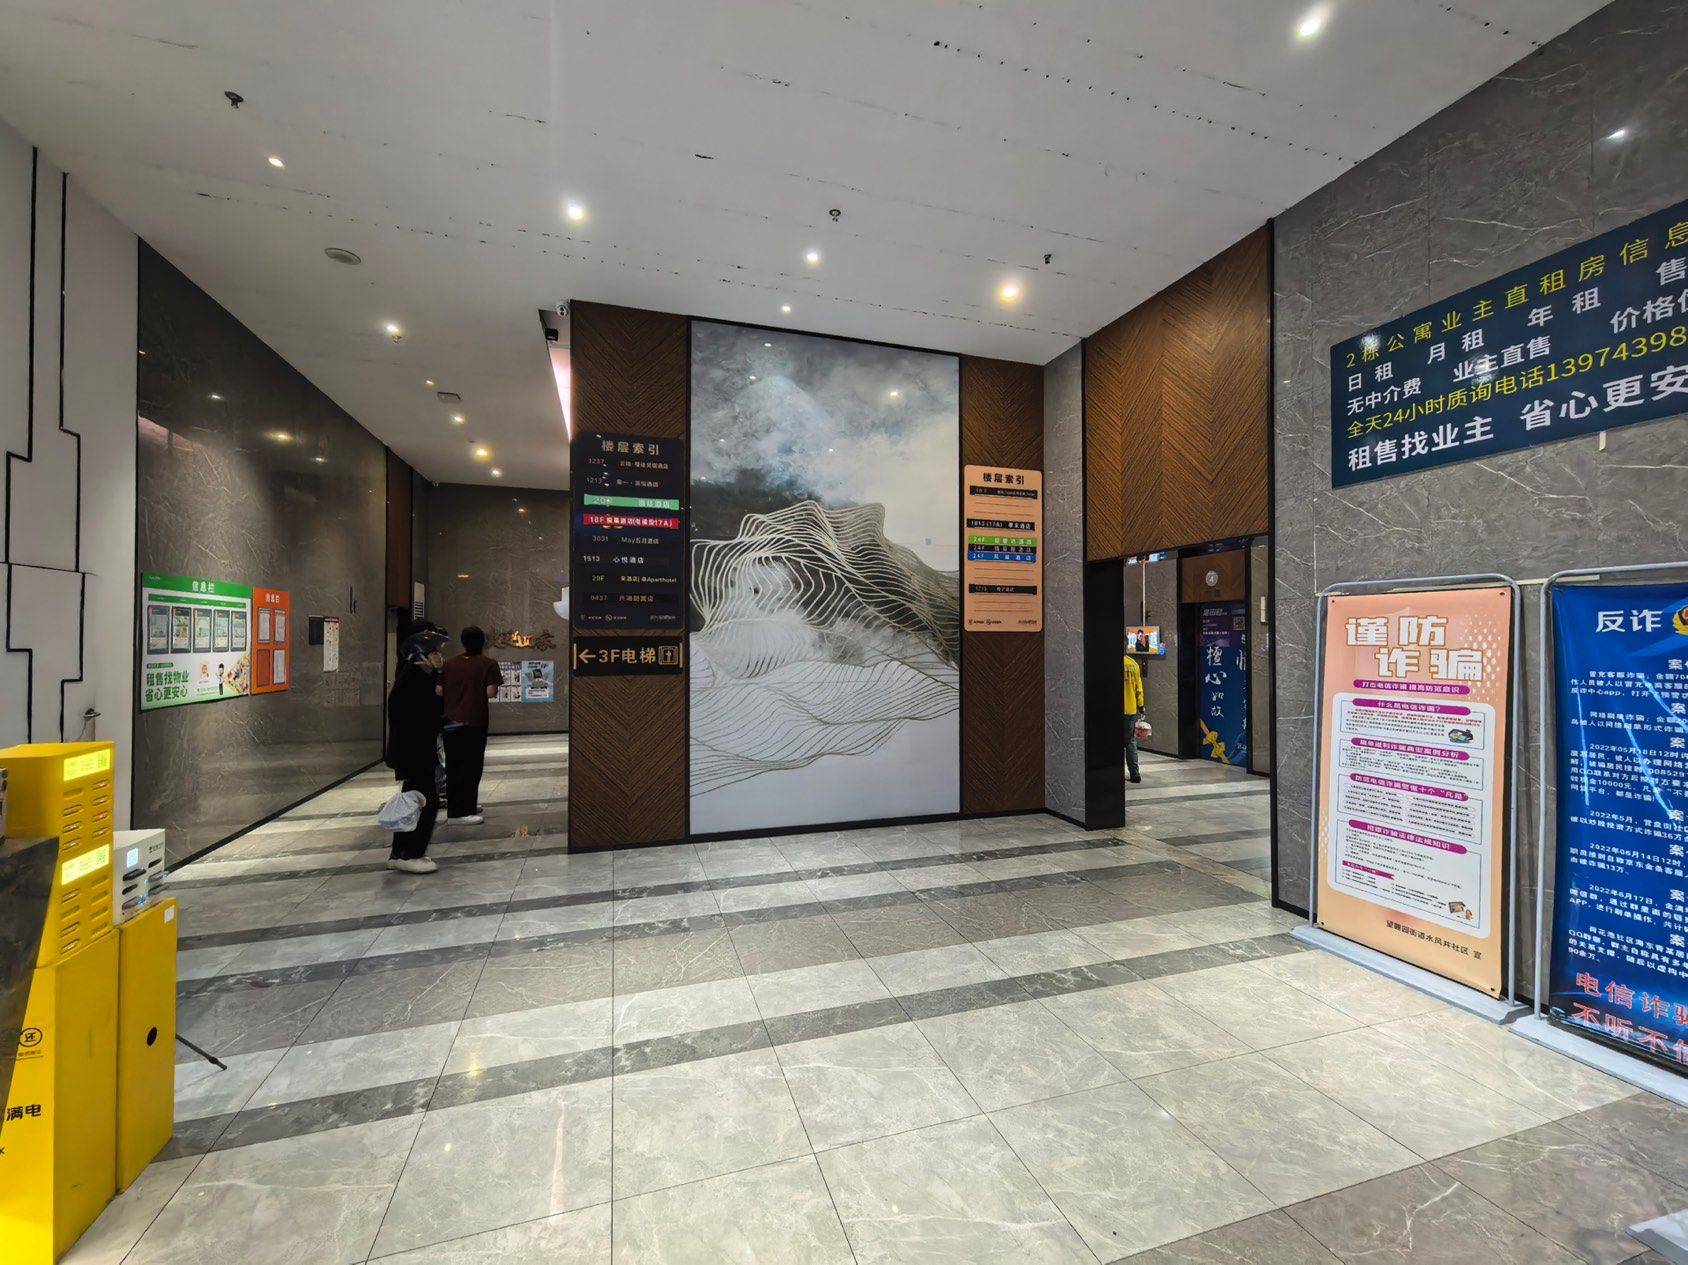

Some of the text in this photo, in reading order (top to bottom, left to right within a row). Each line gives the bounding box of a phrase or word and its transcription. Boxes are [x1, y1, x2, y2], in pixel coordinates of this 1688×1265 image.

[1656, 257, 1688, 285] 售
[1347, 376, 1422, 415] 无中介费
[1453, 335, 1551, 382] 业主直售
[1348, 364, 1688, 472] 租售找业主 省心更安
[602, 440, 658, 455] 楼层索引
[983, 472, 1025, 485] 楼层索引
[192, 581, 215, 593] 信息栏
[1596, 609, 1663, 633] 反诈
[1345, 615, 1448, 646] 谨防
[599, 648, 656, 664] 3F电梯
[1374, 647, 1483, 681] 诈骗
[1668, 658, 1688, 670] 案
[146, 670, 189, 686] 租售找物业
[145, 686, 188, 702] 省心更安心
[6, 1104, 42, 1121] 满电
